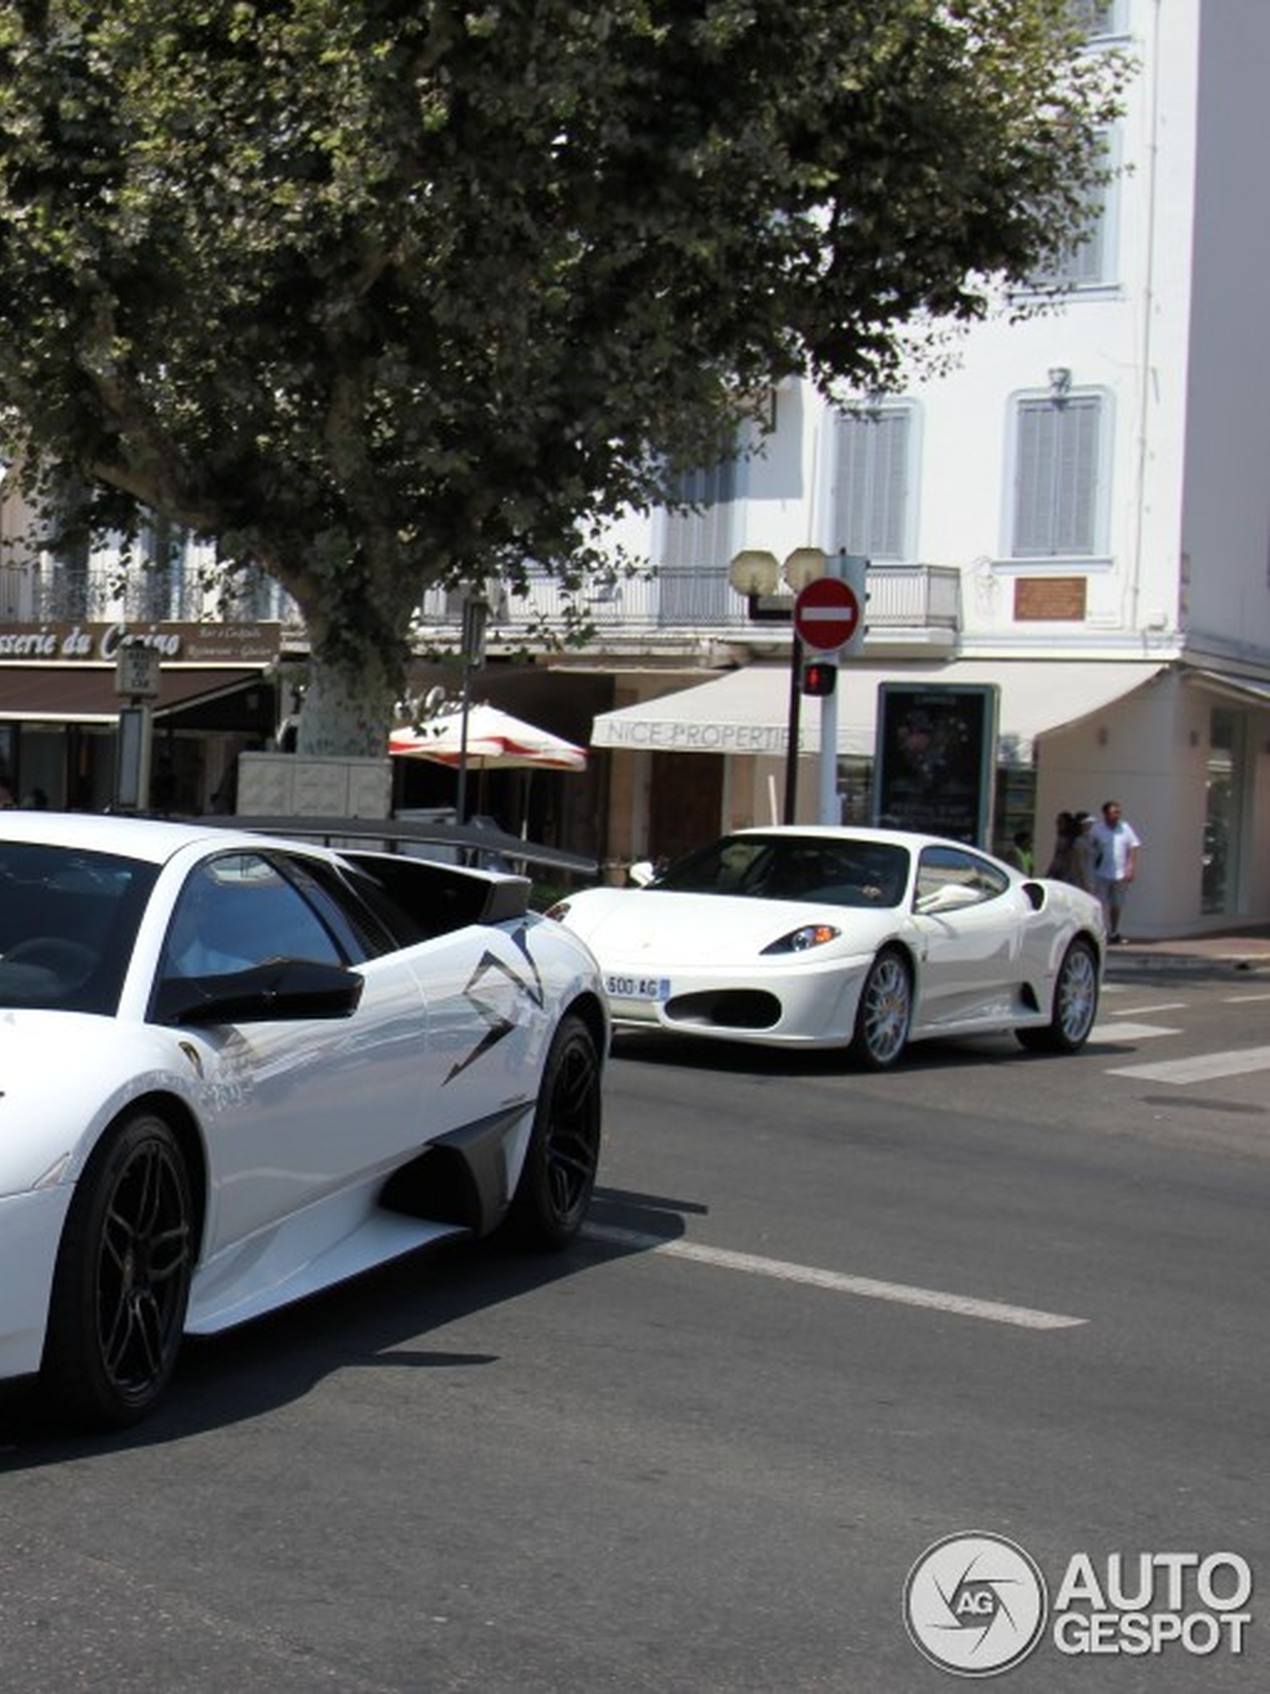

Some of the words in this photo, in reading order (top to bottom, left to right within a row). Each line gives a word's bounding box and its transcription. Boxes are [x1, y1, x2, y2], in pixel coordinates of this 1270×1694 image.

[61, 626, 91, 654] du
[607, 722, 663, 744] NICE
[670, 724, 804, 750] PROPERTIE
